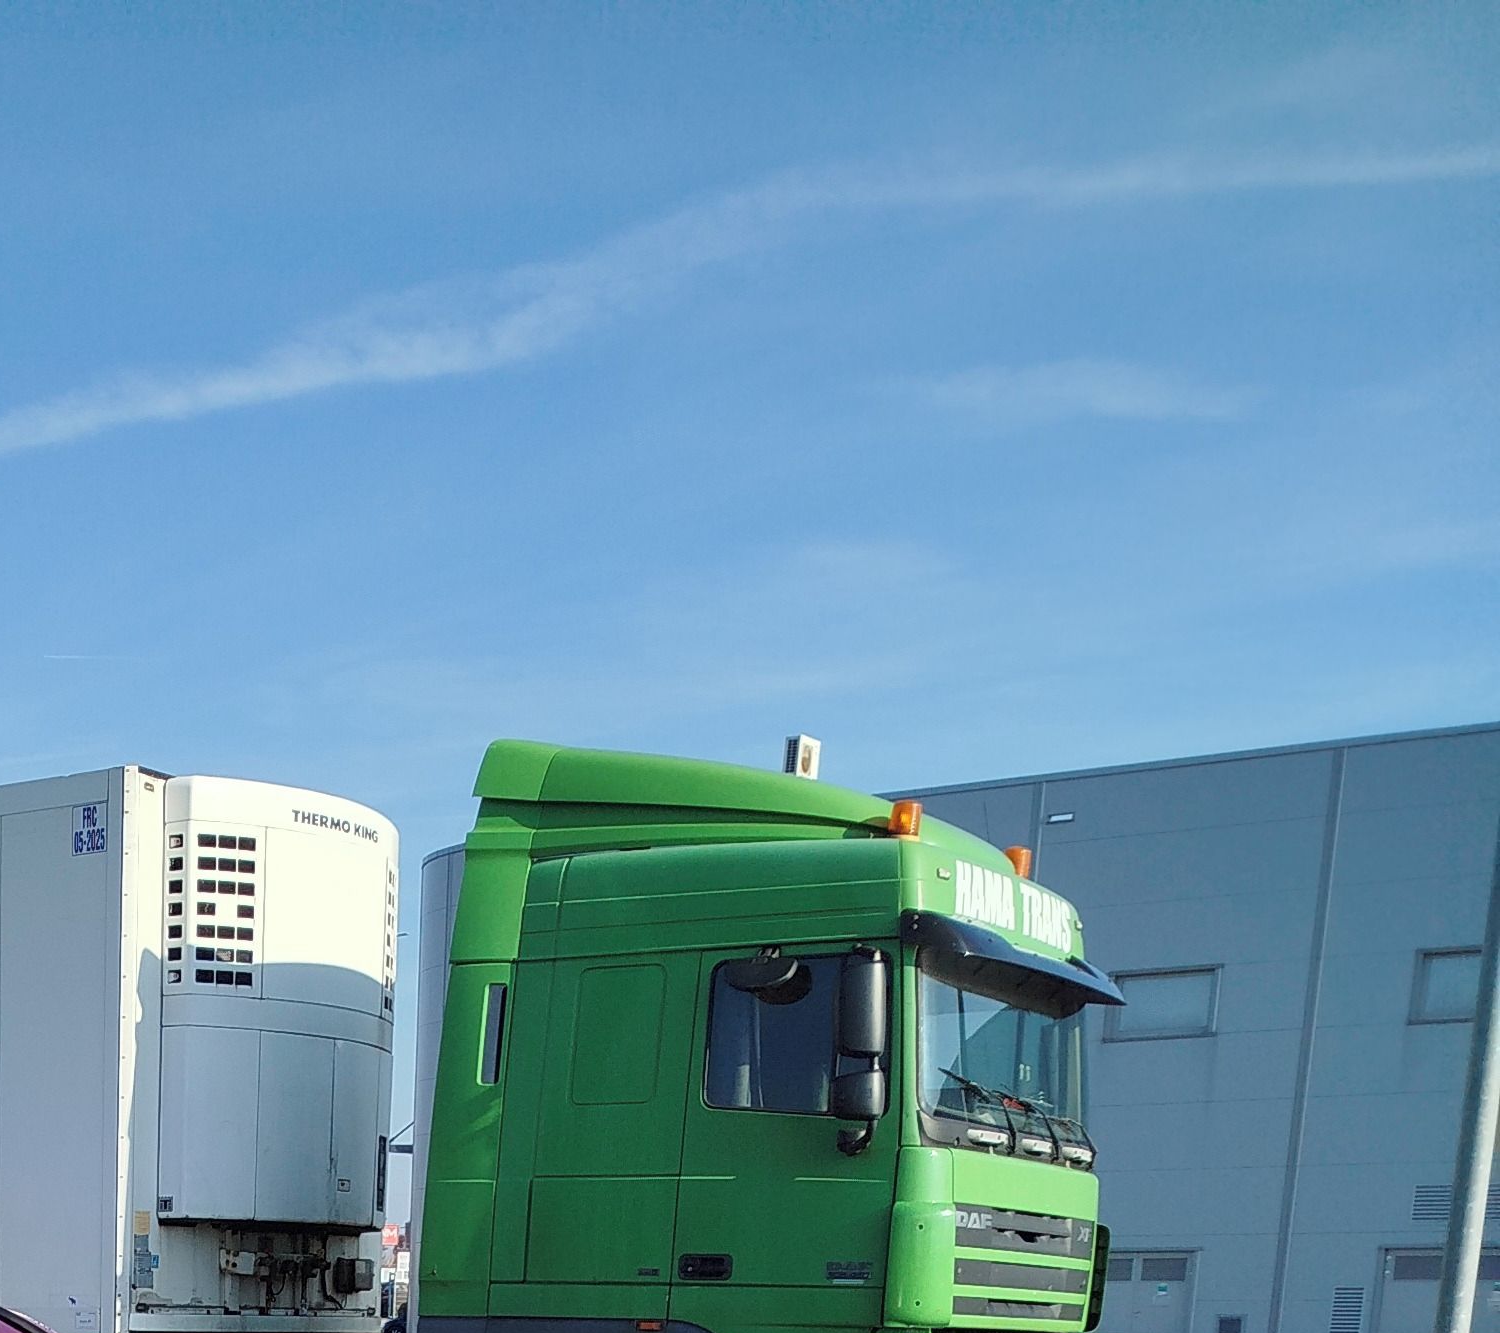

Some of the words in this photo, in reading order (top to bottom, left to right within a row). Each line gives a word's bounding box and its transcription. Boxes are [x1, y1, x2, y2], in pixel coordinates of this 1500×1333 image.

[82, 805, 98, 829] FRC
[291, 808, 351, 834] THERMO
[354, 822, 379, 844] KING
[74, 827, 106, 854] 05-2025
[955, 859, 1016, 931] HAMA
[1019, 881, 1072, 954] TRANS
[955, 1210, 993, 1230] DAF
